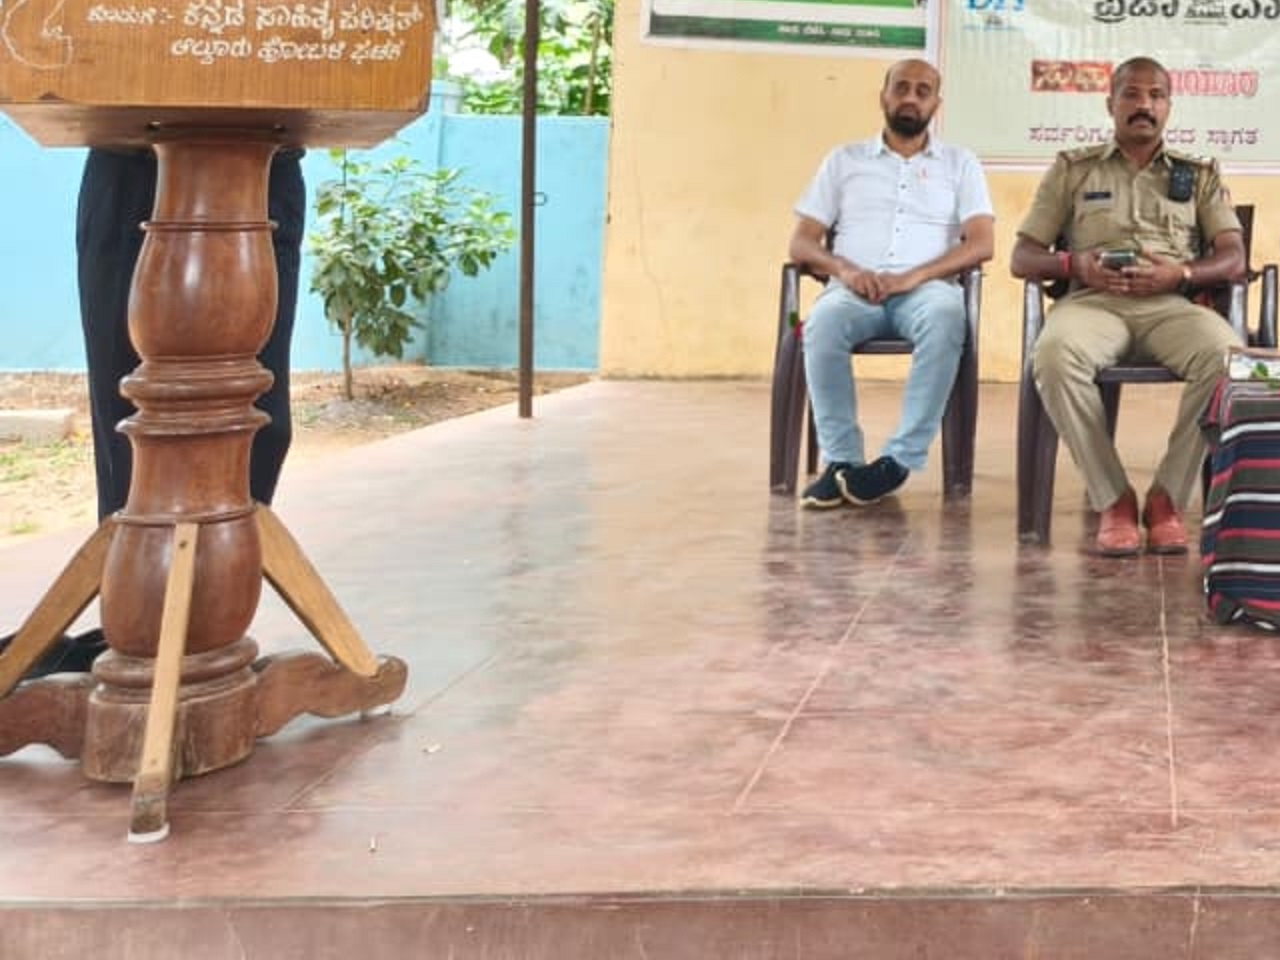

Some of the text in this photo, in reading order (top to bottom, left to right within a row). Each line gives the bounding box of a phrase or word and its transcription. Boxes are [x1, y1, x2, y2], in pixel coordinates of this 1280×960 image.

[256, 0, 335, 39] ಸಾಹಿತ್ಯ
[339, 1, 424, 37] ಪರಿಷತ್
[171, 37, 252, 65] ಆಲ್ದೂರು
[351, 39, 406, 64] ಘಟಕ
[1207, 126, 1259, 151] ಸ್ವಾಗತ
